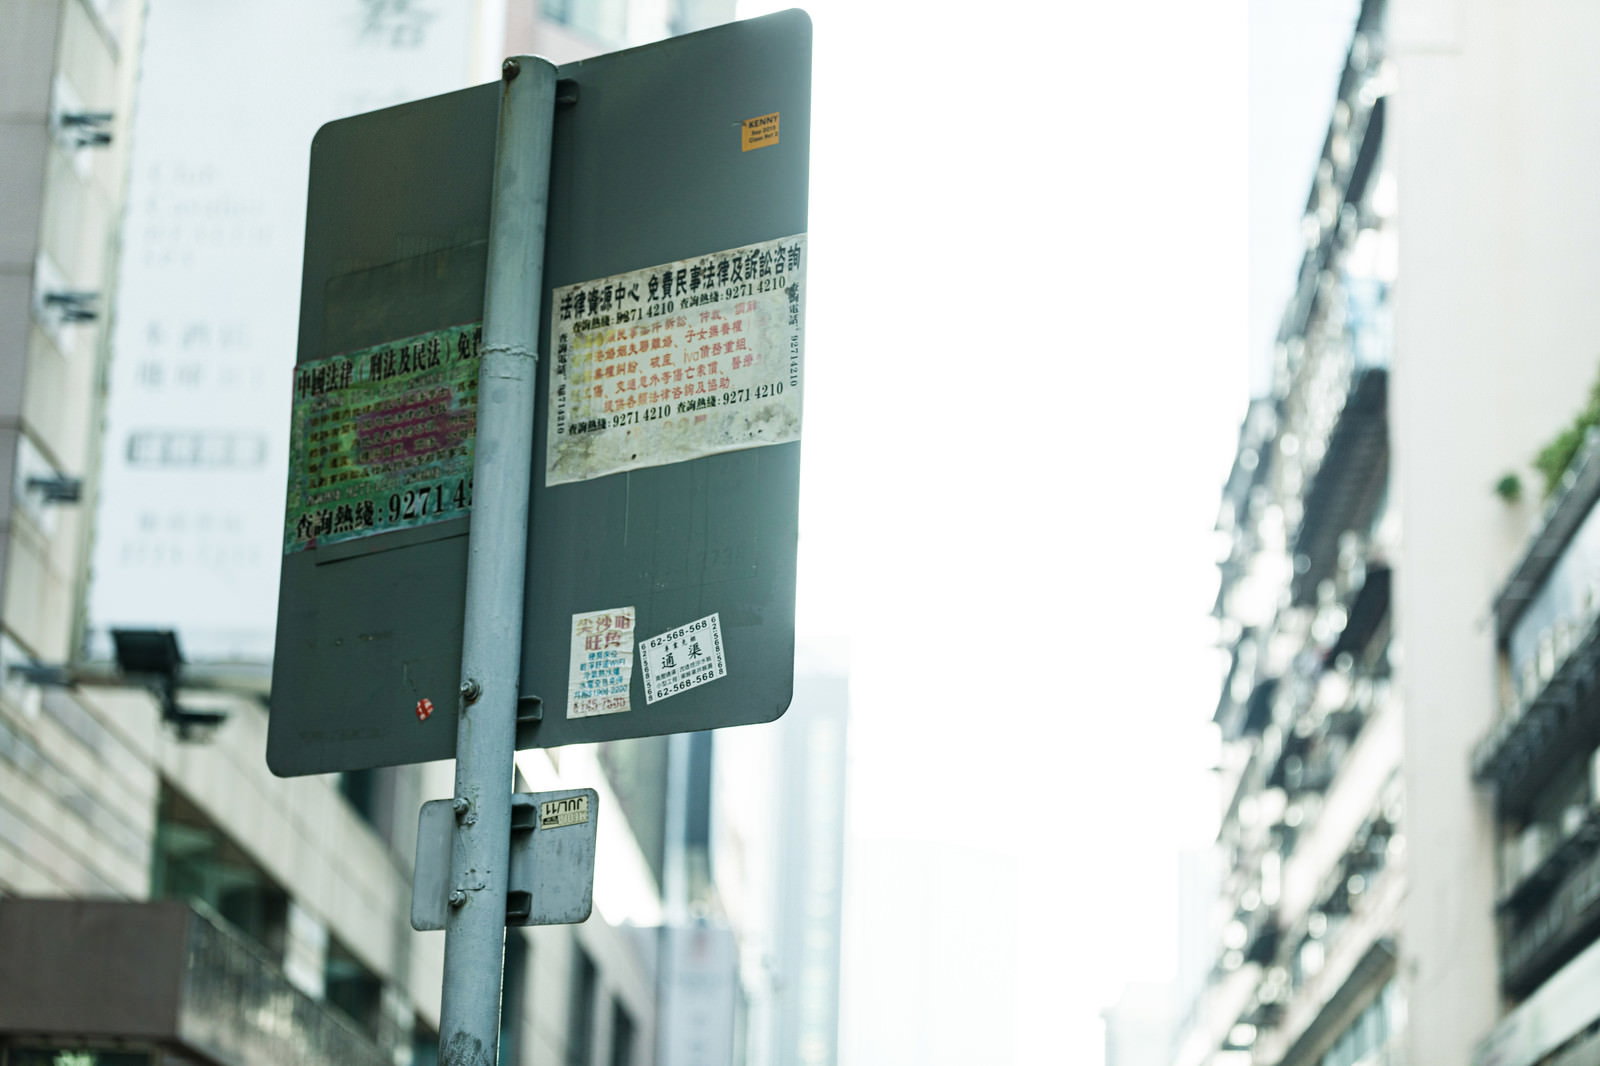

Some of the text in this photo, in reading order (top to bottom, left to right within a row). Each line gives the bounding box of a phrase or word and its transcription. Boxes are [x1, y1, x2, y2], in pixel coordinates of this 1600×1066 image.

[748, 115, 777, 128] KENNY
[560, 242, 801, 321] 法律資源中心 免費民事法律及訴訟咨詢
[643, 404, 671, 421] 4210
[755, 381, 783, 399] 4210
[650, 620, 708, 648] 62-568-568
[657, 671, 714, 698] 62-568-568
[546, 798, 583, 815] JUL/11
